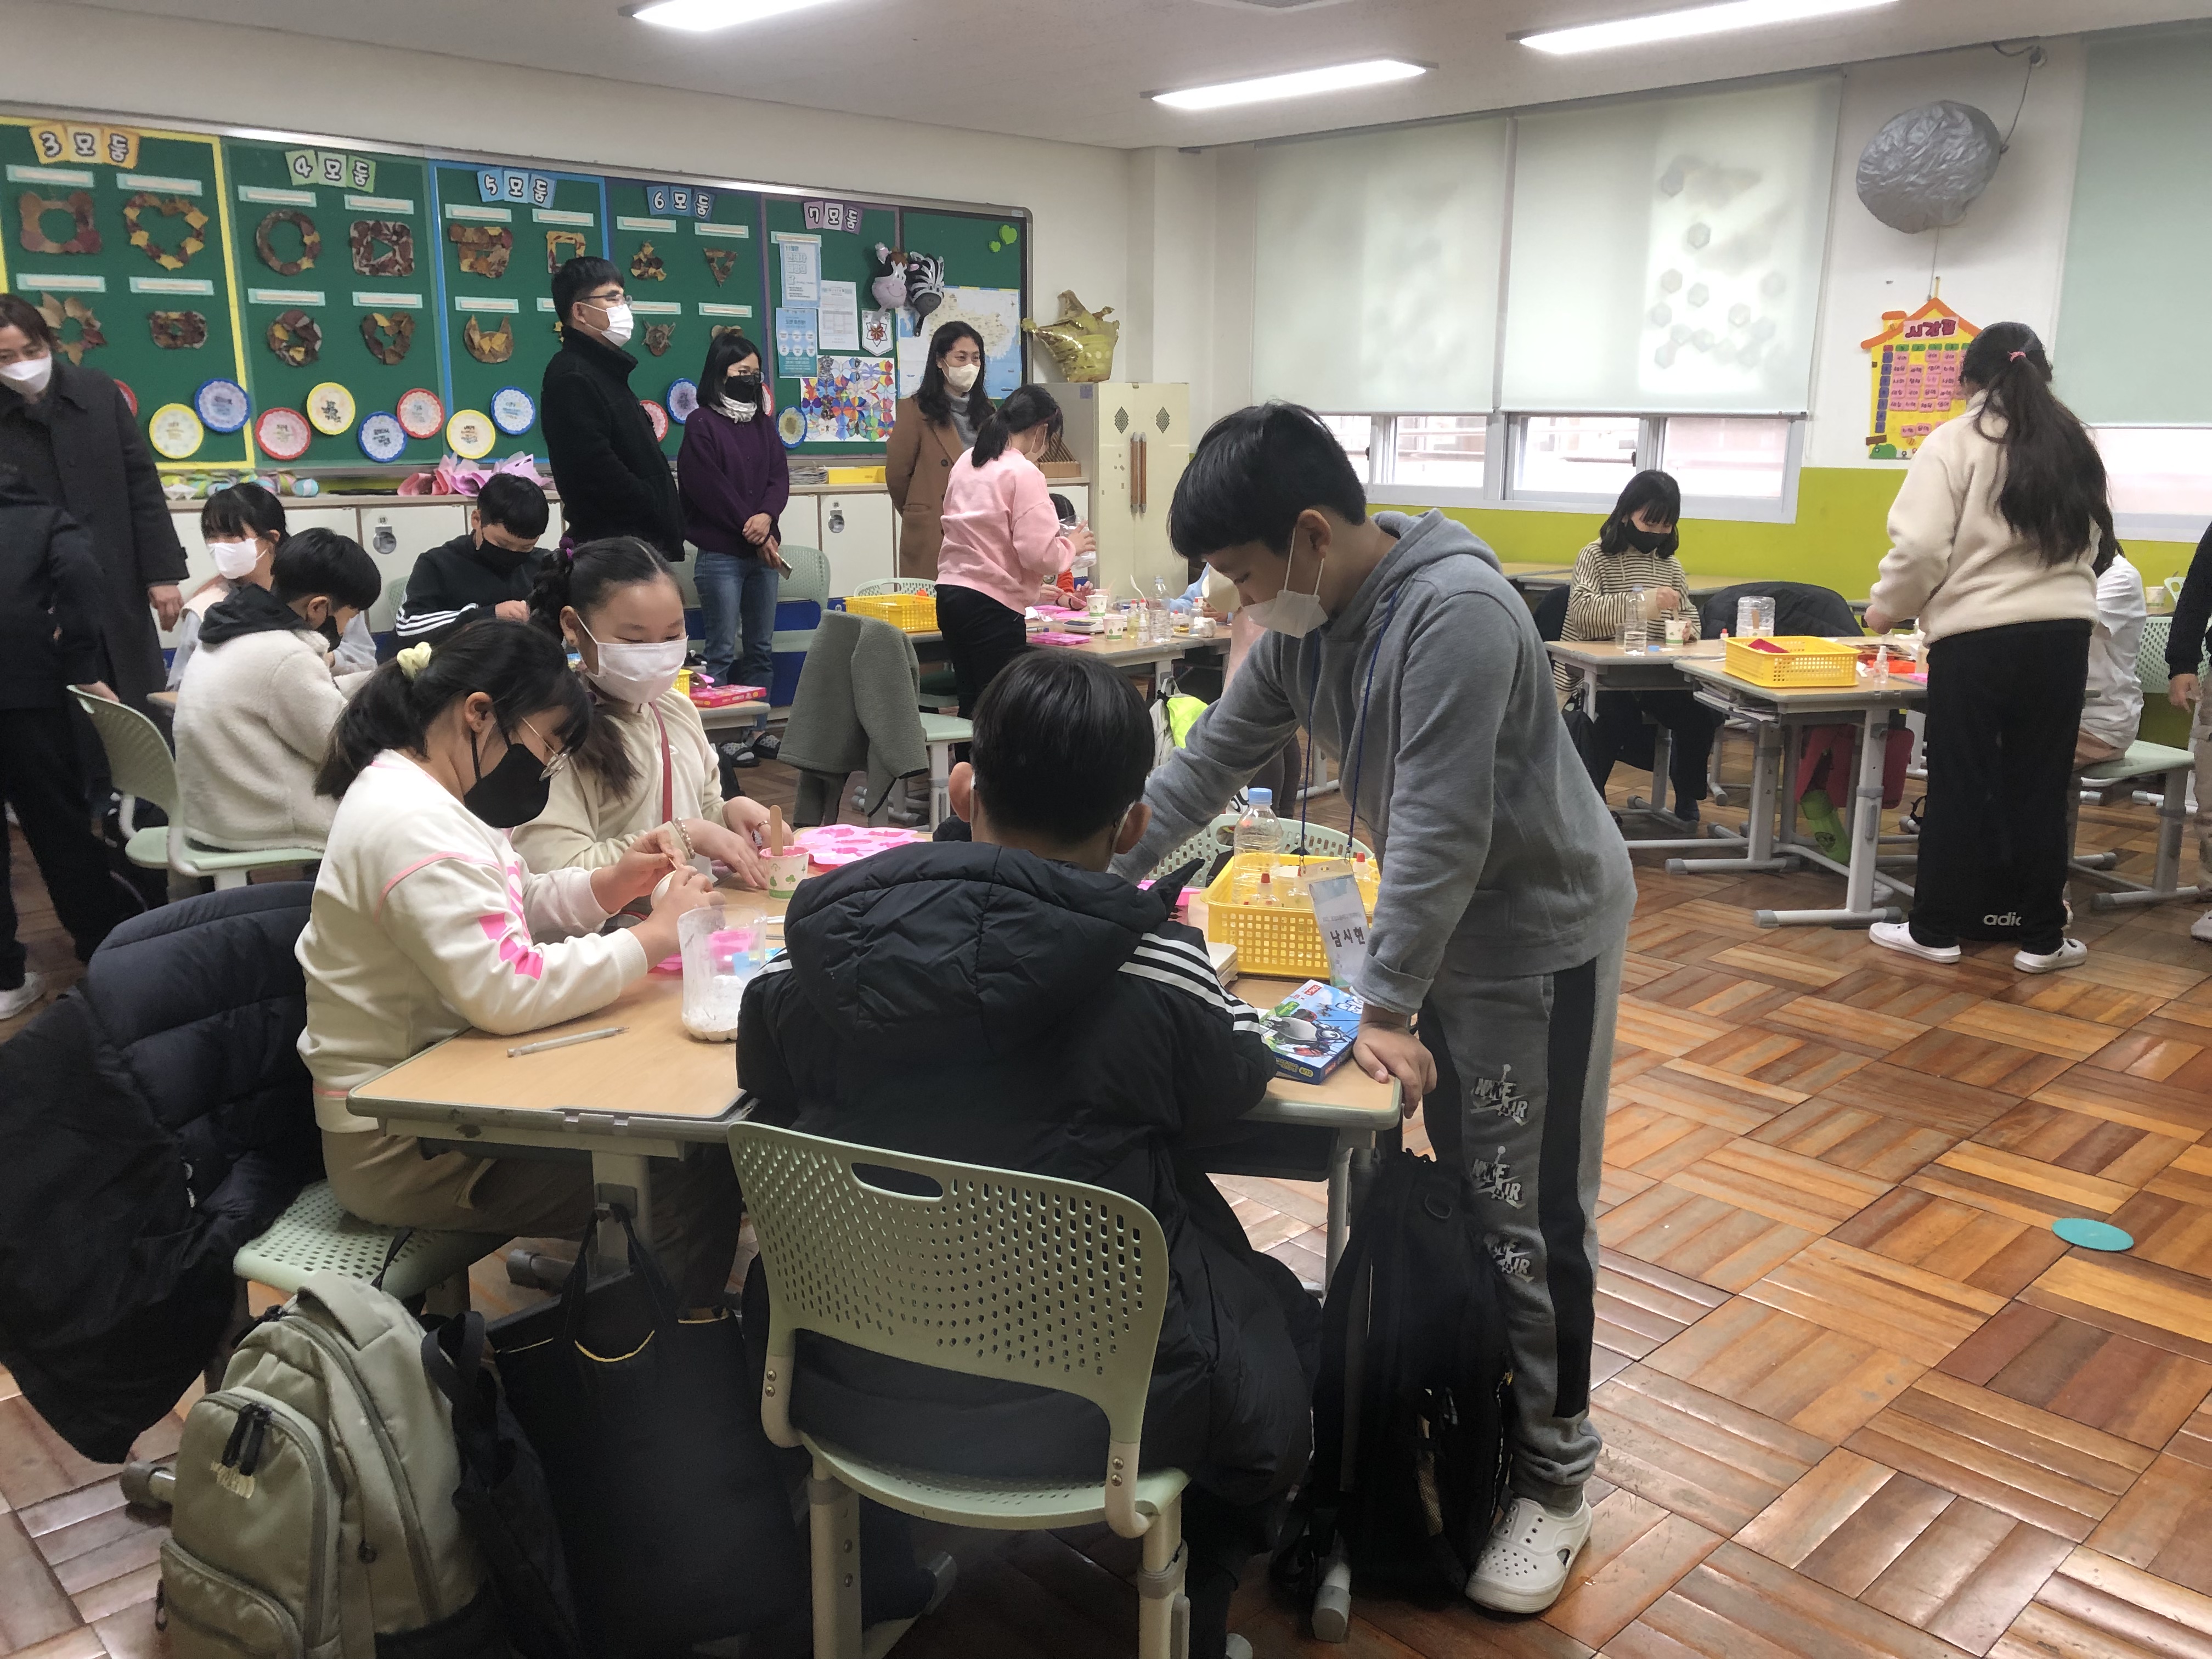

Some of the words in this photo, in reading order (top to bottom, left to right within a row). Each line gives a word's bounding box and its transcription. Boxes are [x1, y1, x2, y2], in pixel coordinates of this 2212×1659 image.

[40, 131, 130, 163] 3모둠
[292, 156, 370, 187] 4모둠
[483, 173, 549, 204] 5모둠
[653, 193, 711, 217] 6모둠
[808, 206, 858, 229] 7모둠
[1330, 927, 1365, 947] 남시현
